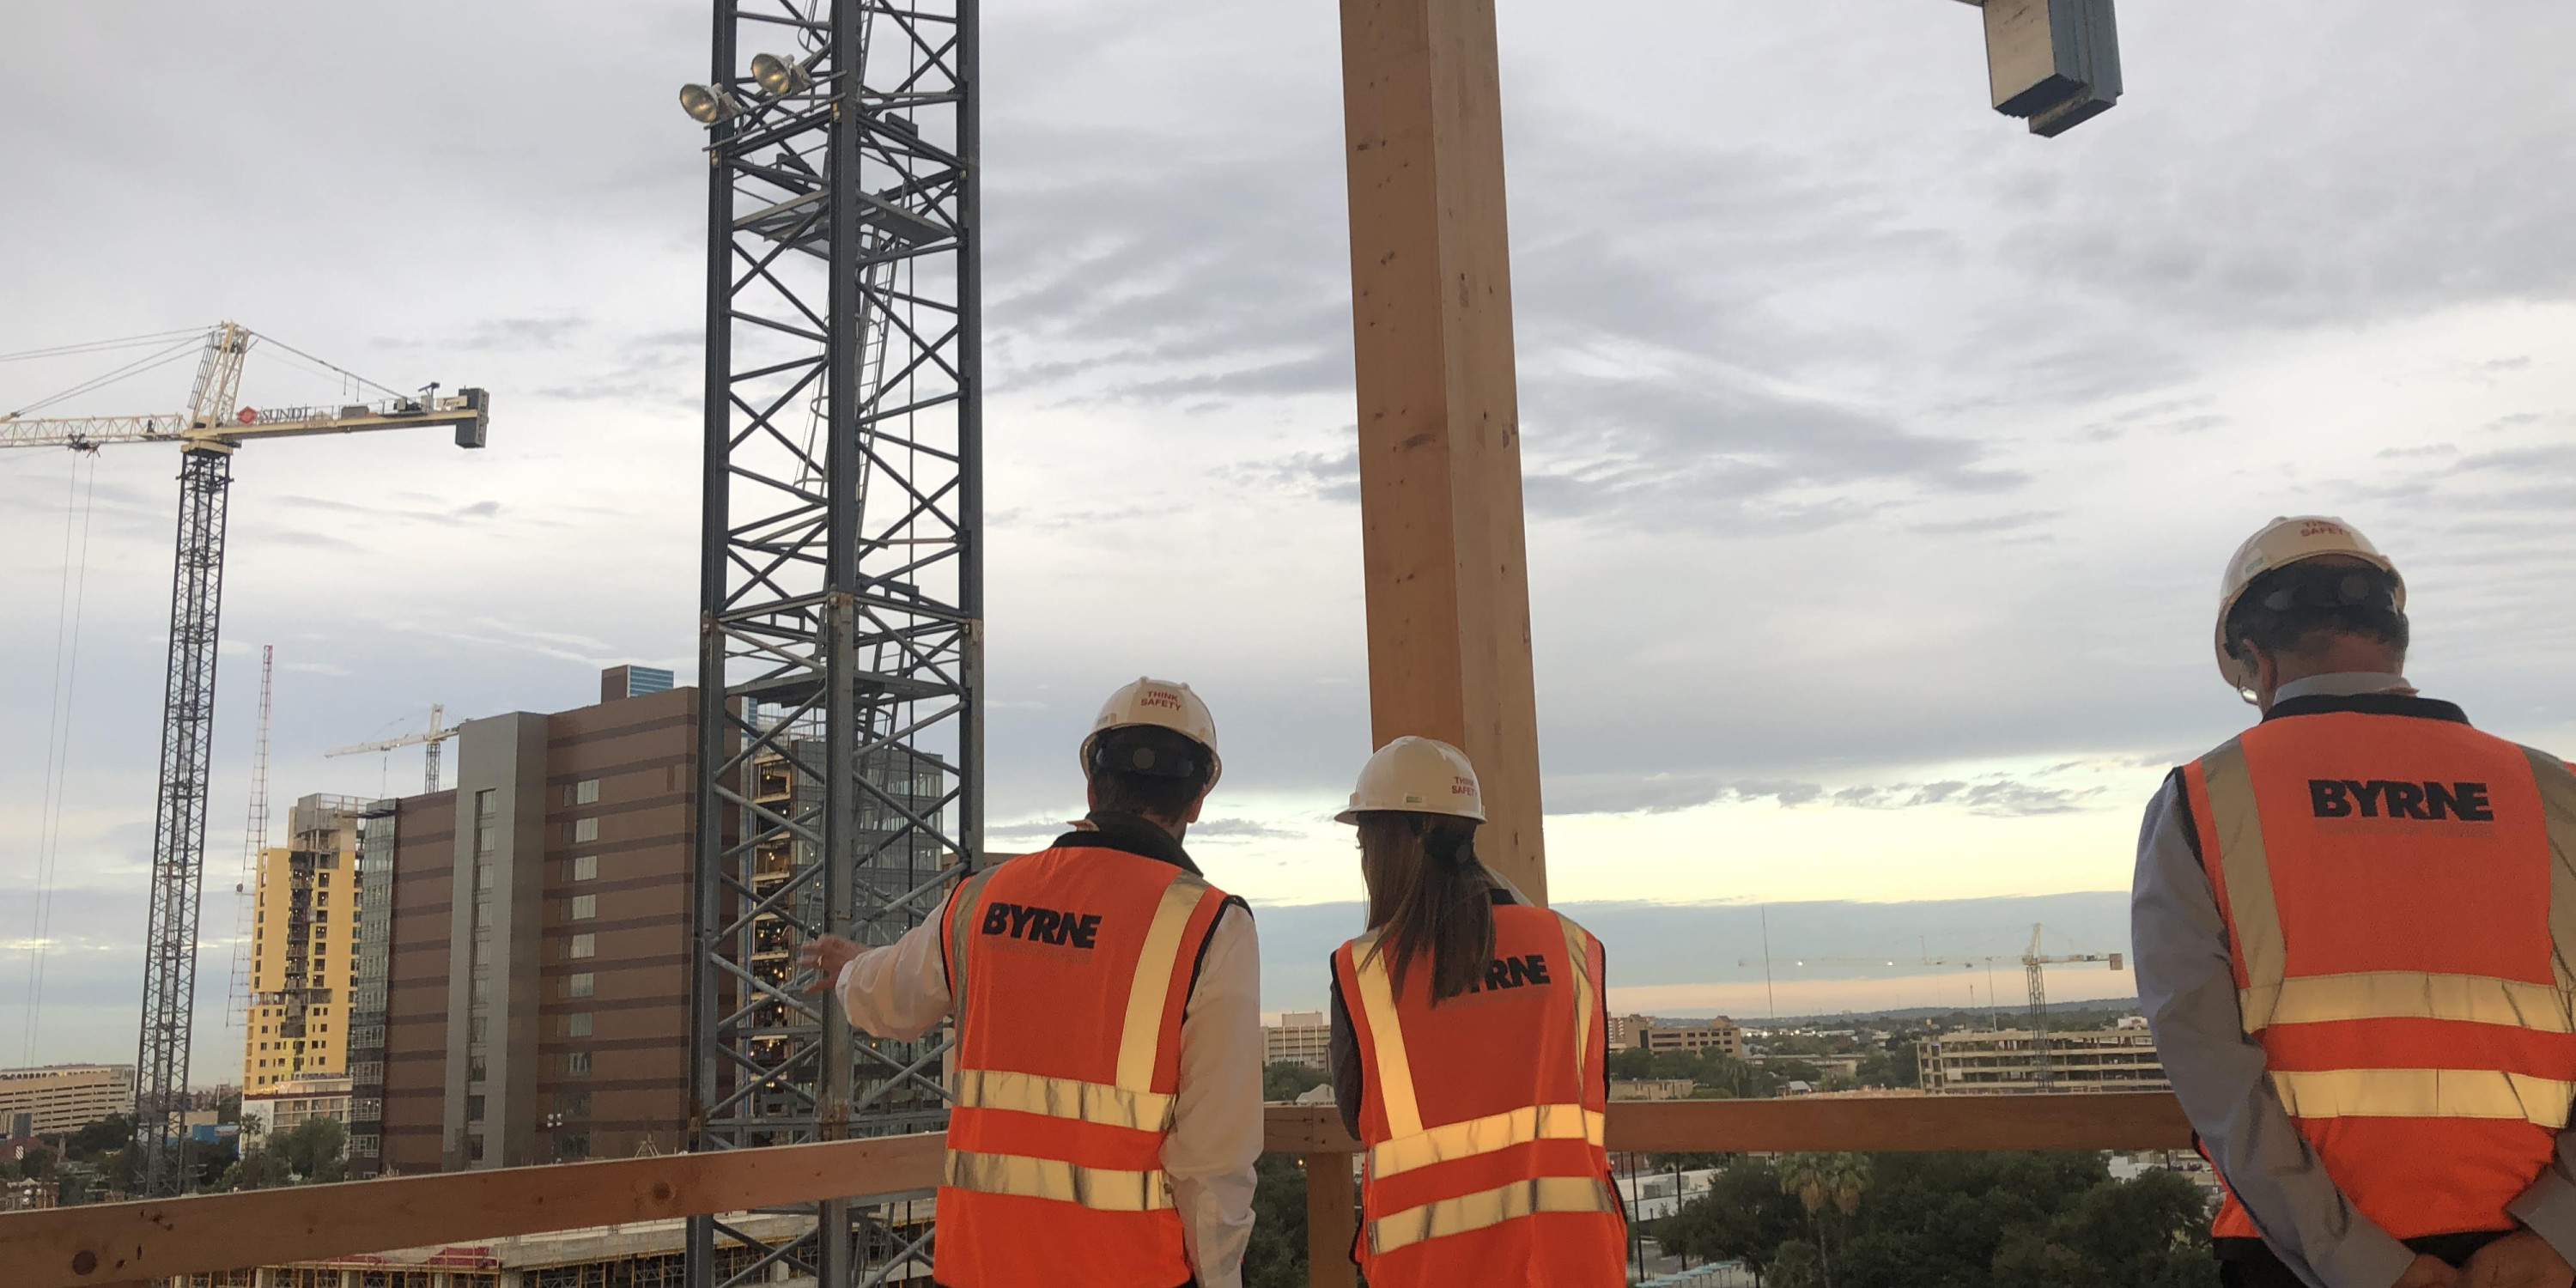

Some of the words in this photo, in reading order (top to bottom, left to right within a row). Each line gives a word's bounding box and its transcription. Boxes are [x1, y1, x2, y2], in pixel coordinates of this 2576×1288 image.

[1140, 698, 1182, 712] SAFETY
[1147, 690, 1179, 702] THINK
[2308, 779, 2494, 821] BYRNE
[981, 902, 1103, 949] BYRNE
[1467, 955, 1551, 993] RNE
